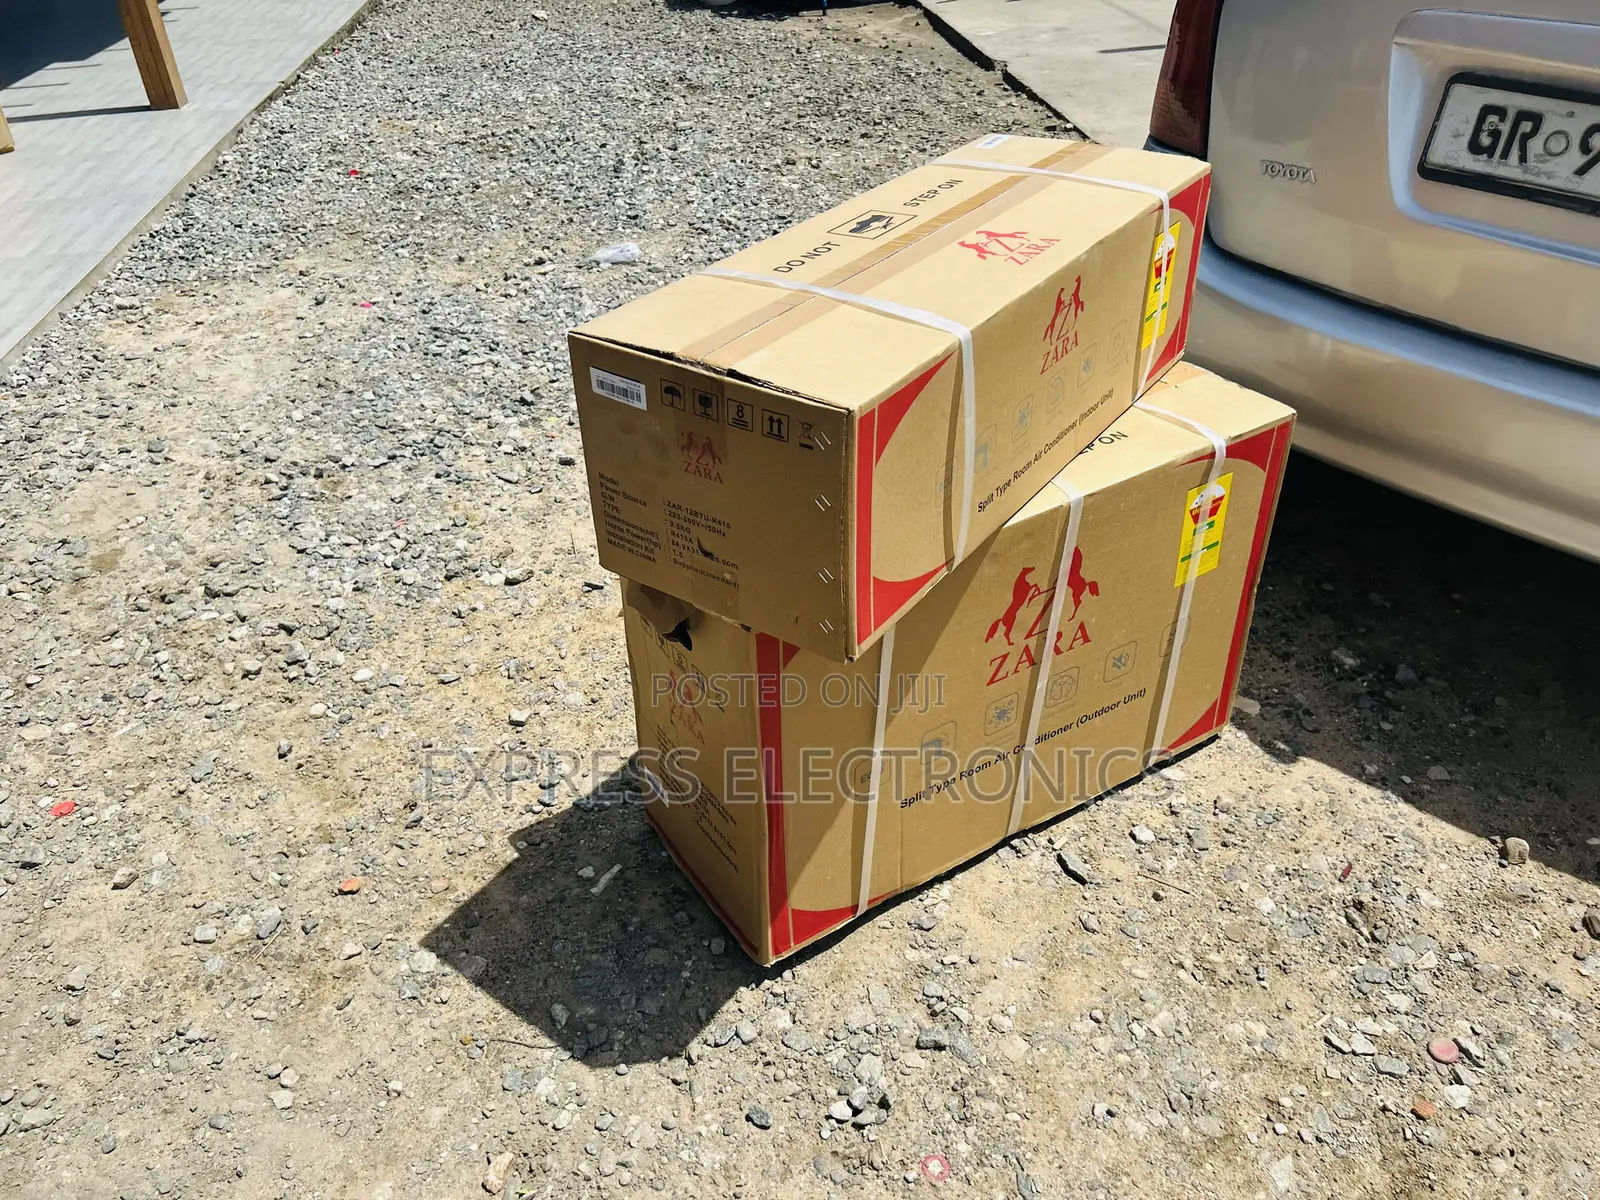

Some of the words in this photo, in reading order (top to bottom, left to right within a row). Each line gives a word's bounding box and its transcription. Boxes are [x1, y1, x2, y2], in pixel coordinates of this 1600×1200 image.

[1260, 159, 1317, 184] TOYOTA
[903, 189, 937, 209] STEP
[937, 178, 964, 191] ON
[772, 260, 805, 274] DO
[801, 240, 842, 260] NOT
[1003, 238, 1062, 266] ZARA
[1040, 330, 1079, 375] ZARA
[1098, 430, 1129, 445] ON
[977, 493, 994, 513] Split
[995, 479, 1013, 501] Type
[1012, 461, 1033, 482] Room
[1033, 451, 1043, 465] Air
[1043, 419, 1079, 455] Conditioner
[1078, 403, 1101, 426] (Indoor
[1100, 388, 1113, 406] Unit)
[599, 472, 620, 487] Model
[683, 461, 724, 485] ZARA
[600, 482, 621, 497] Power
[622, 490, 648, 507] Source
[602, 500, 621, 515] TYPE
[605, 520, 626, 533] Horse
[607, 538, 627, 552] MADE
[900, 789, 927, 809] Split
[928, 775, 957, 796] Type
[959, 759, 992, 781] Room
[993, 750, 1011, 765] Air
[1075, 700, 1122, 729] (Outdoor
[1122, 687, 1147, 707] Unit)
